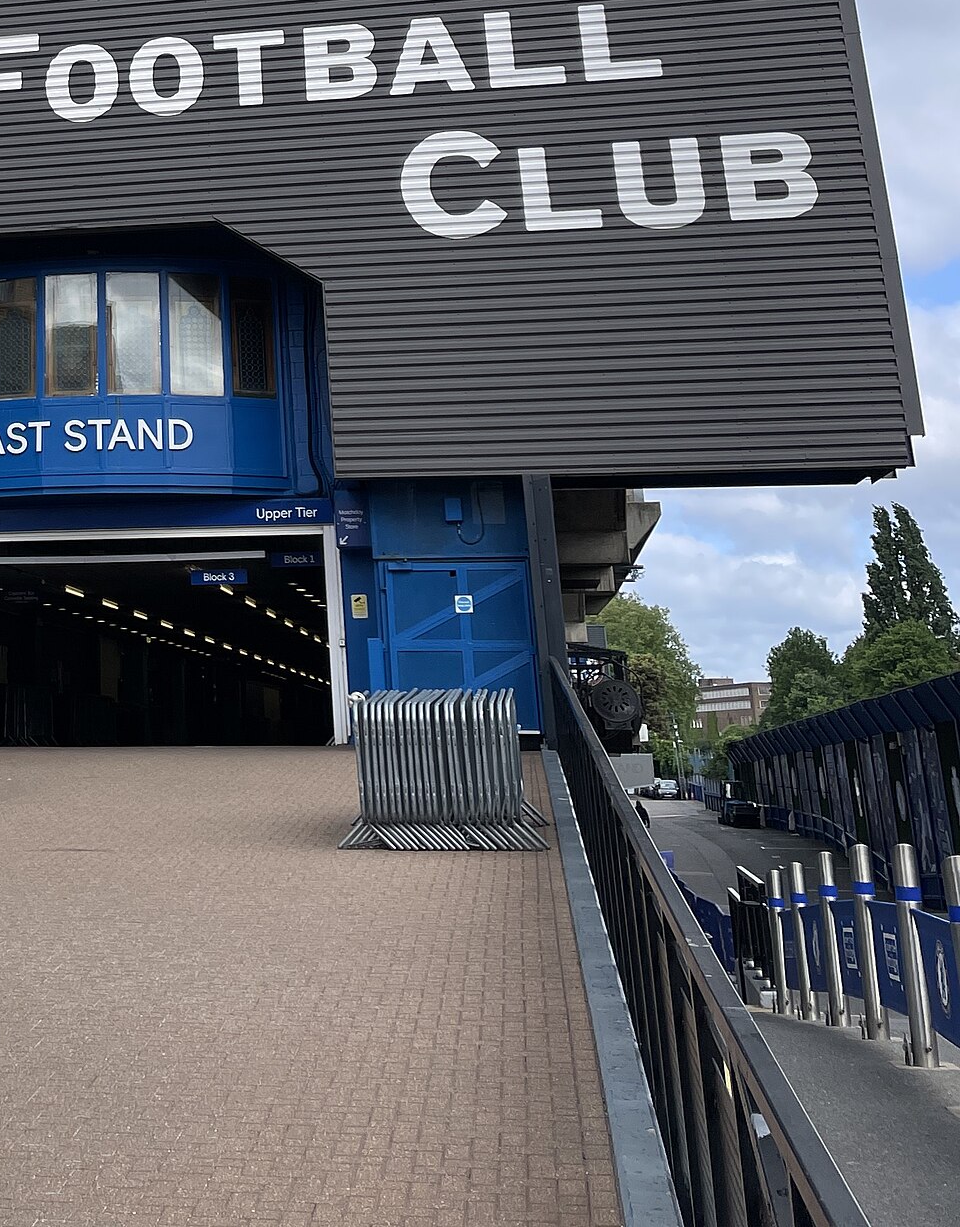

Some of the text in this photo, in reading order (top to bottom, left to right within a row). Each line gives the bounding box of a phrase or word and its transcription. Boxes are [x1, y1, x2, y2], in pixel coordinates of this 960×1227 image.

[399, 130, 820, 240] CLUB
[63, 418, 194, 452] STAND
[256, 506, 318, 521] Upper Tier
[283, 553, 315, 565] Block 1
[203, 572, 235, 582] Block 3
